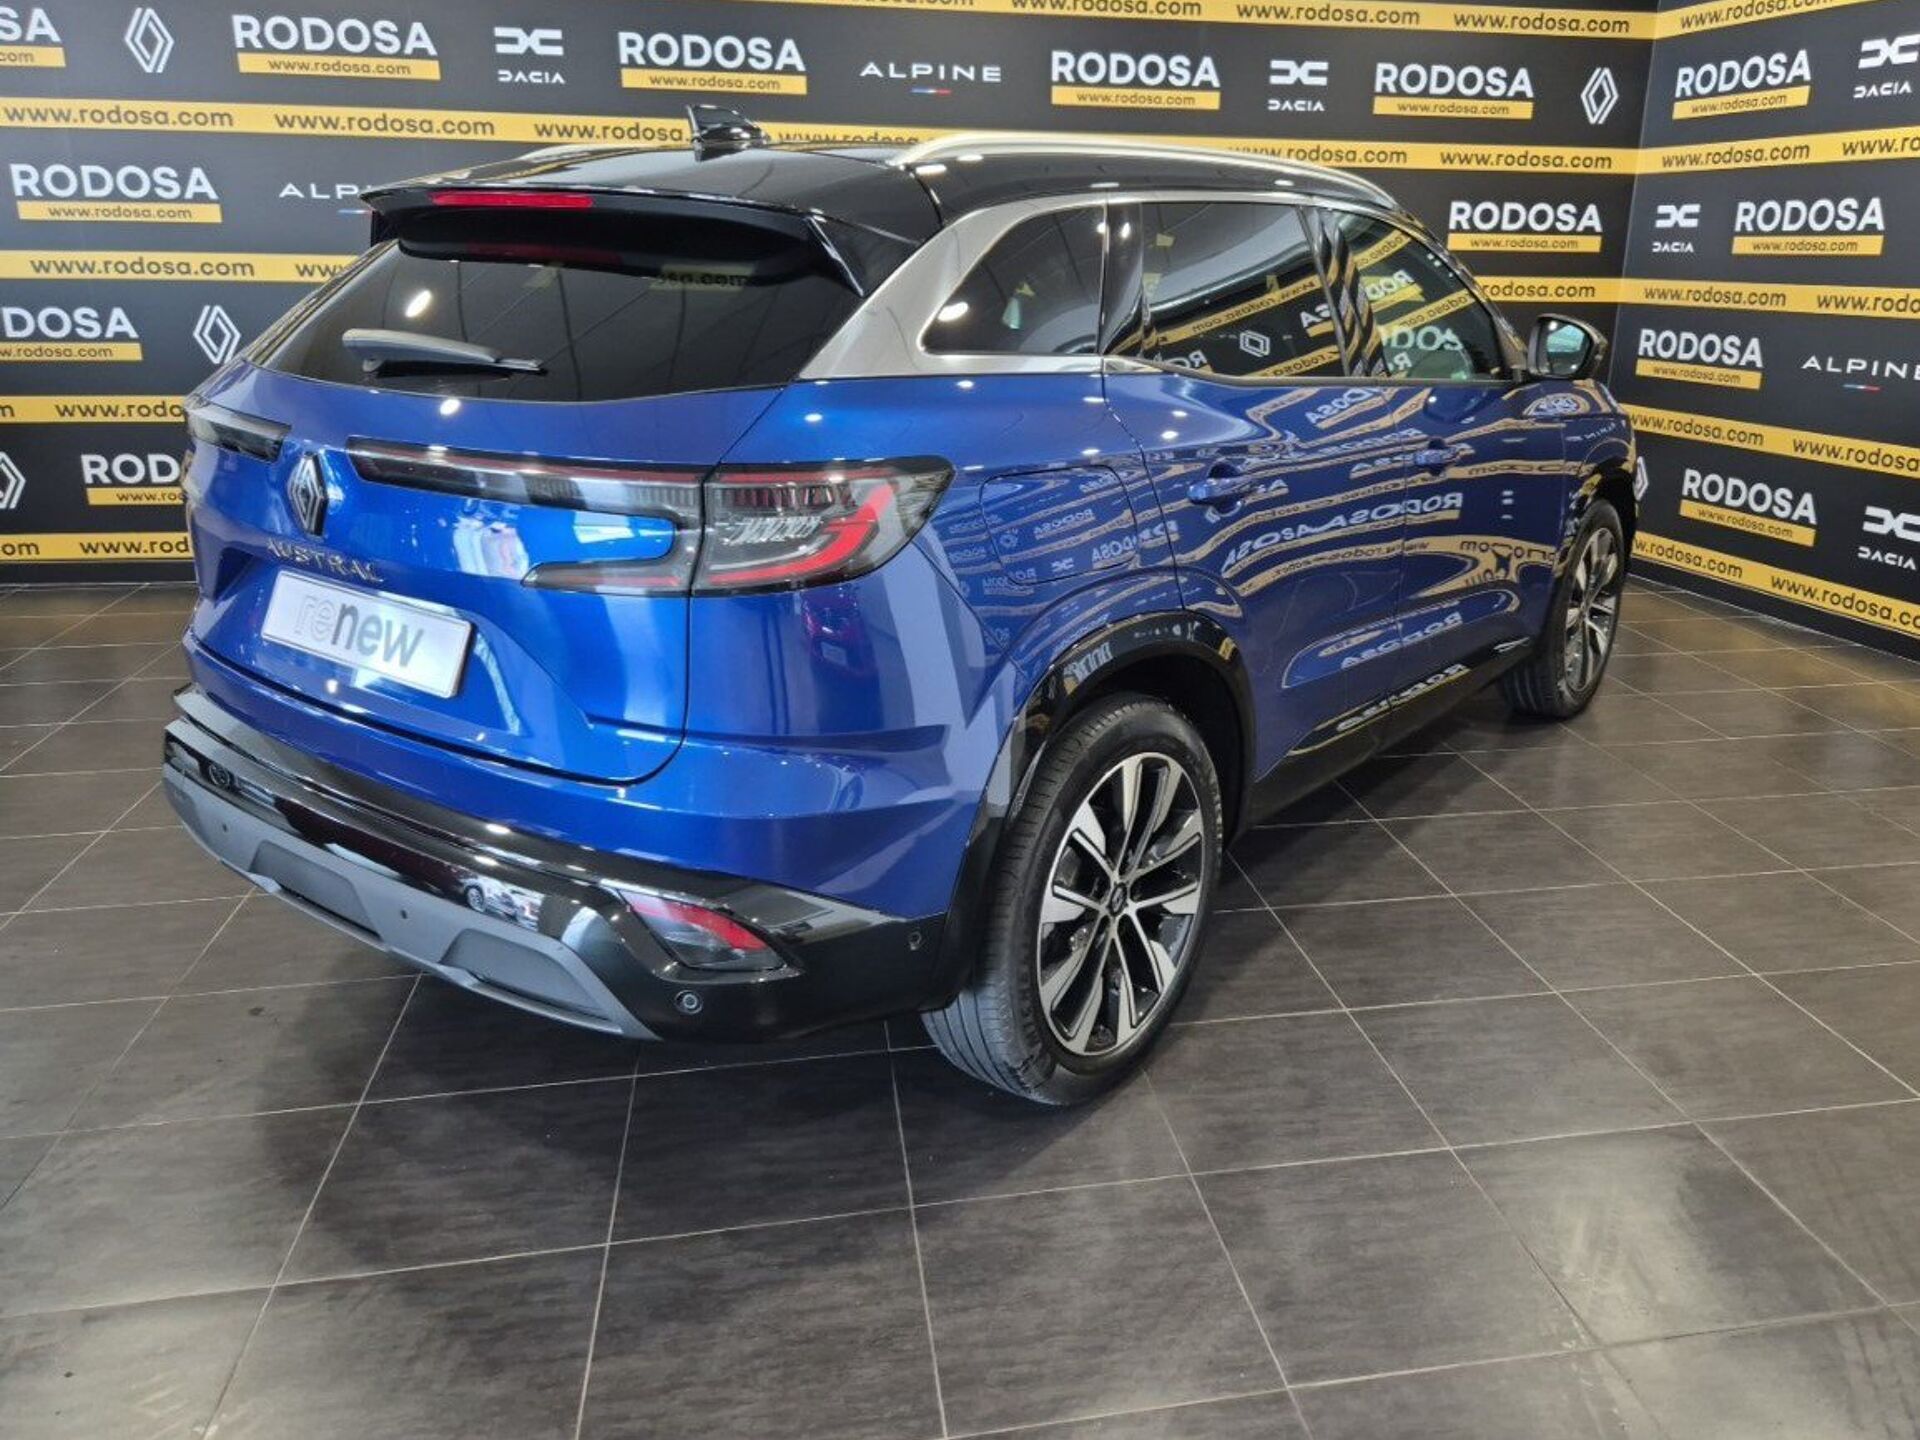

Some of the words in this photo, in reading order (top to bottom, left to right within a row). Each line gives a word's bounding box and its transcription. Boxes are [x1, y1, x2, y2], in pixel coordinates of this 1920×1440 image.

[1237, 2, 1420, 25] www.rodosa.com
[1453, 13, 1630, 34] www.rodosa.com
[232, 14, 438, 56] RODOSA
[618, 32, 807, 71] RODOSA
[267, 57, 411, 76] www.rodosa.com
[498, 70, 565, 84] DACIA
[860, 62, 1001, 82] ALPINE
[1051, 51, 1221, 88] RODOSA
[1675, 50, 1812, 98] RODOSA
[649, 73, 780, 91] www.rodosa.com
[1374, 62, 1534, 98] RODOSA
[1853, 82, 1912, 99] DACIA
[1076, 91, 1195, 107] www.rodosa.com
[1268, 99, 1324, 112] DACIA
[1397, 102, 1509, 116] www.rodosa.com
[1691, 93, 1787, 113] www.rodosa.com
[4, 105, 234, 127] www.rodosa.com
[274, 112, 495, 136] www.rodosa.com
[1440, 150, 1612, 169] www.rodosa.com
[1662, 143, 1810, 168] www.rodosa.com
[9, 163, 218, 200] RODOSA
[48, 205, 192, 220] www.rodosa.com
[1450, 201, 1602, 232] RODOSA
[1734, 197, 1885, 232] RODOSA
[1470, 238, 1578, 250] www.rodosa.com
[1653, 242, 1695, 253] DACIA
[1752, 239, 1858, 252] www.rodosa.com
[30, 256, 254, 277] www.rodosa.com
[1645, 284, 1786, 307] www.rodosa.com
[1638, 328, 1764, 368] RODOSA
[1653, 364, 1741, 385] www.rodosa.com
[80, 453, 180, 484] ROD
[1681, 468, 1817, 525] RODOSA
[1697, 507, 1792, 538] www.rodosa.com
[1857, 546, 1917, 571] DACIA
[295, 594, 424, 667] renew
